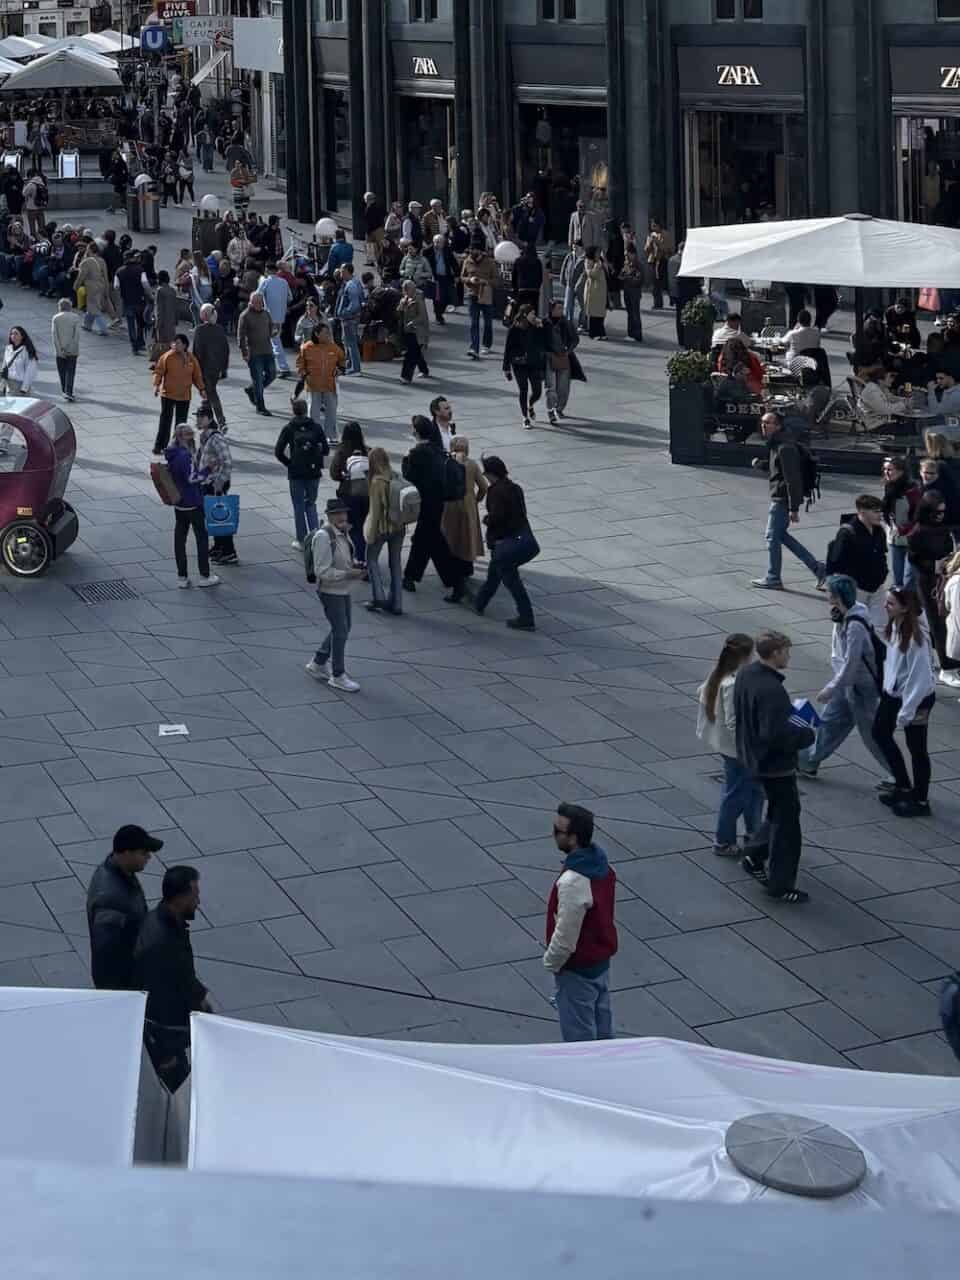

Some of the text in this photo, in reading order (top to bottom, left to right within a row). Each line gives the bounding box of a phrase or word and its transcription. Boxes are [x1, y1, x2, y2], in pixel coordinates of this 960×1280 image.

[163, 10, 190, 18] GUYS
[165, 2, 187, 10] FIVE
[146, 31, 163, 49] U
[412, 57, 439, 75] ZARA
[717, 65, 762, 86] ZARA
